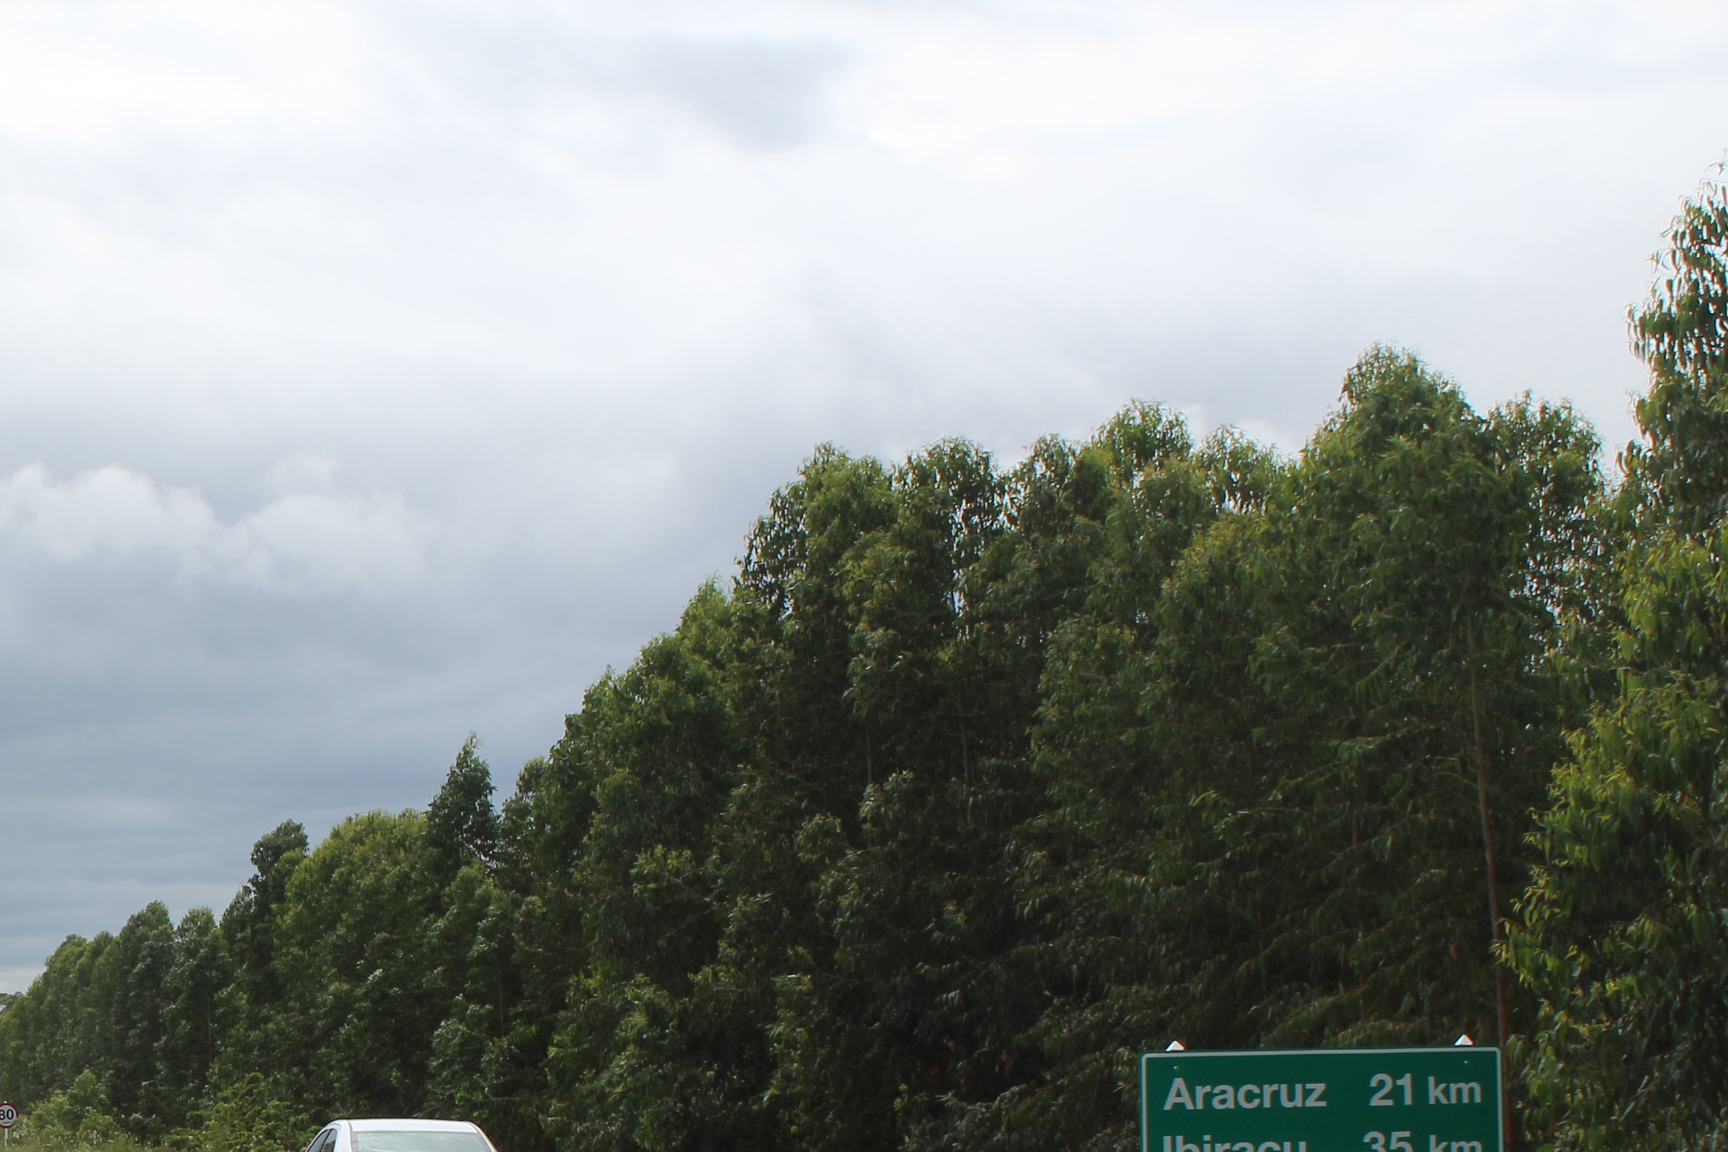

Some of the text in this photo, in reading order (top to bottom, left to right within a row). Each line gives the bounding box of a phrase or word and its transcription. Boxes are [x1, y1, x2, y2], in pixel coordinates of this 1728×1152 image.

[1162, 1073, 1482, 1111] Aracruz 21 km
